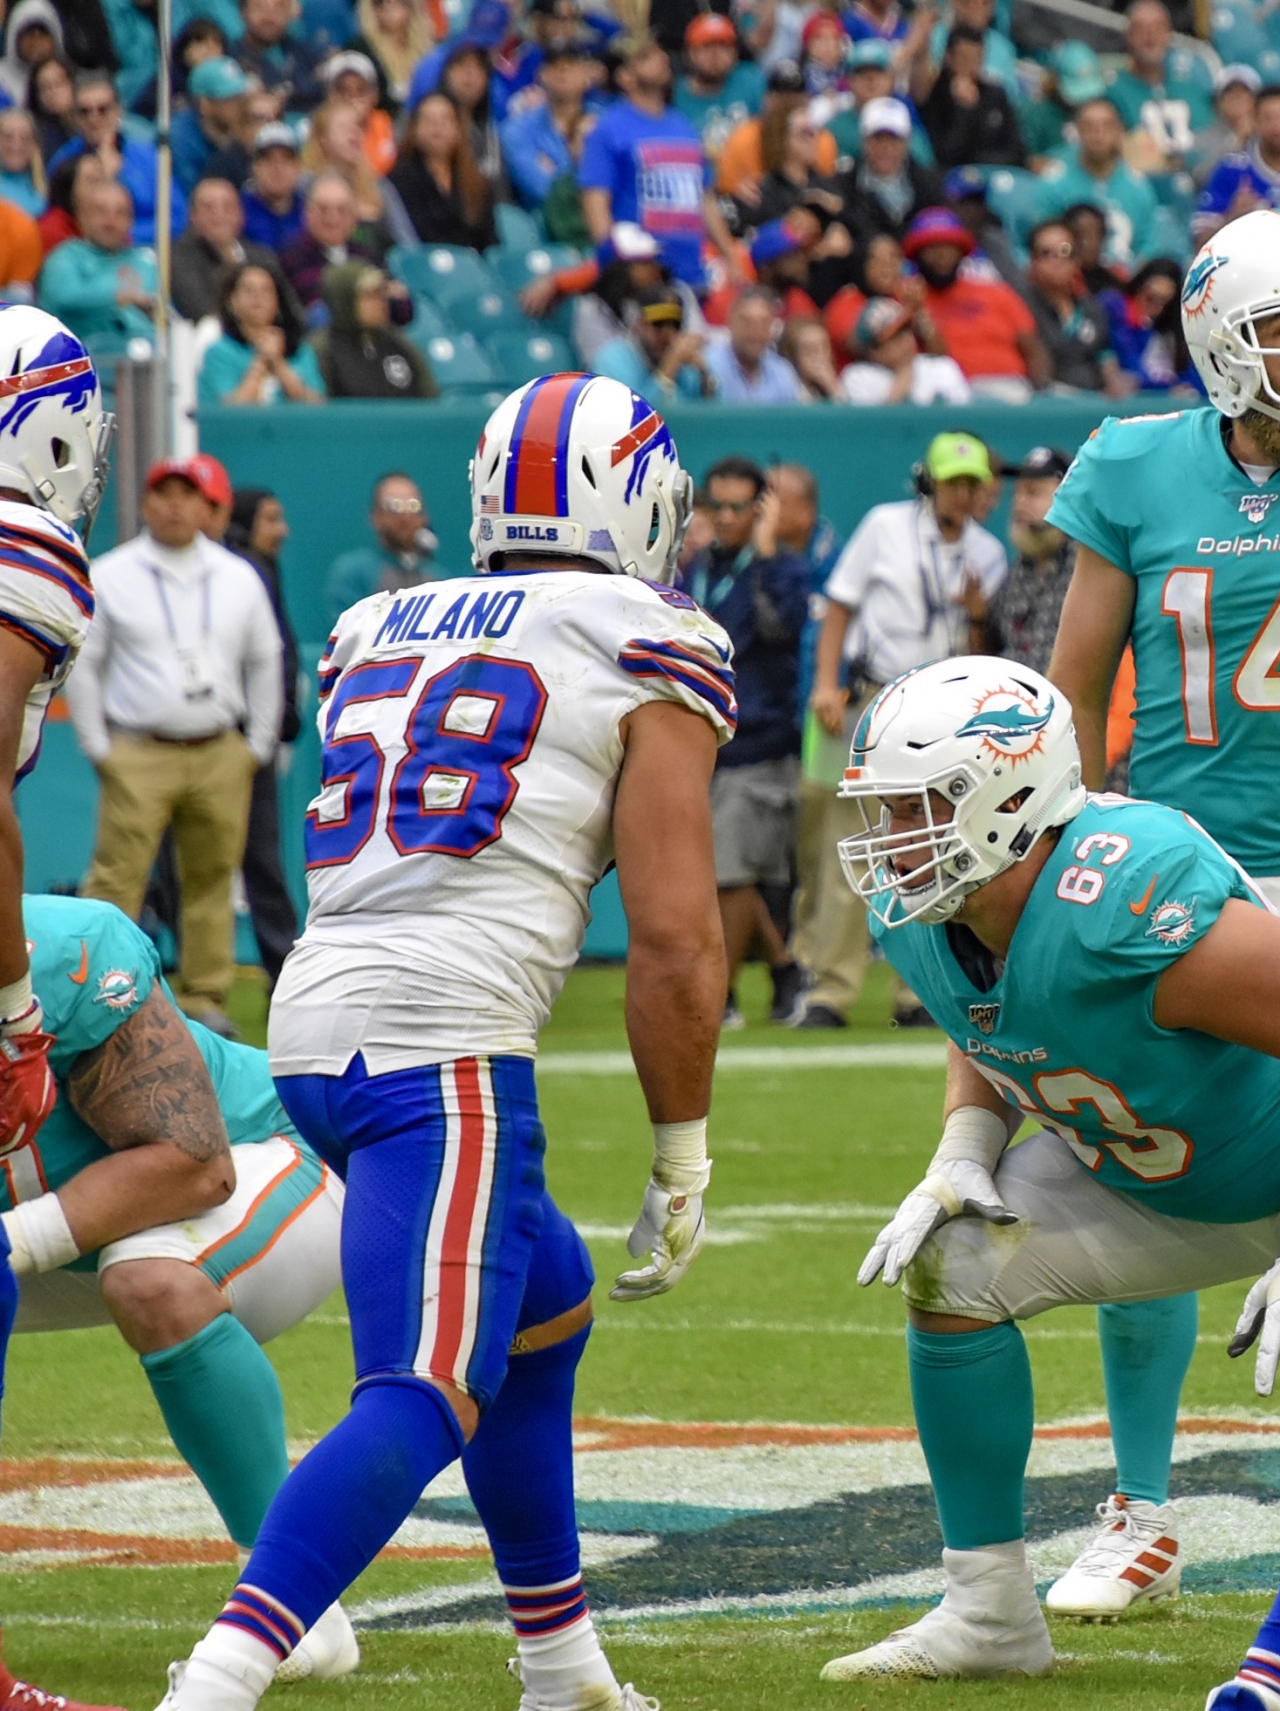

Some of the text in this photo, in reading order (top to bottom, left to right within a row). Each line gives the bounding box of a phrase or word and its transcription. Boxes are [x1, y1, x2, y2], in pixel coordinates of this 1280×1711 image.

[506, 525, 559, 541] BILLS
[372, 590, 526, 648] MILANO
[305, 653, 550, 872] 58
[1055, 832, 1132, 906] 63
